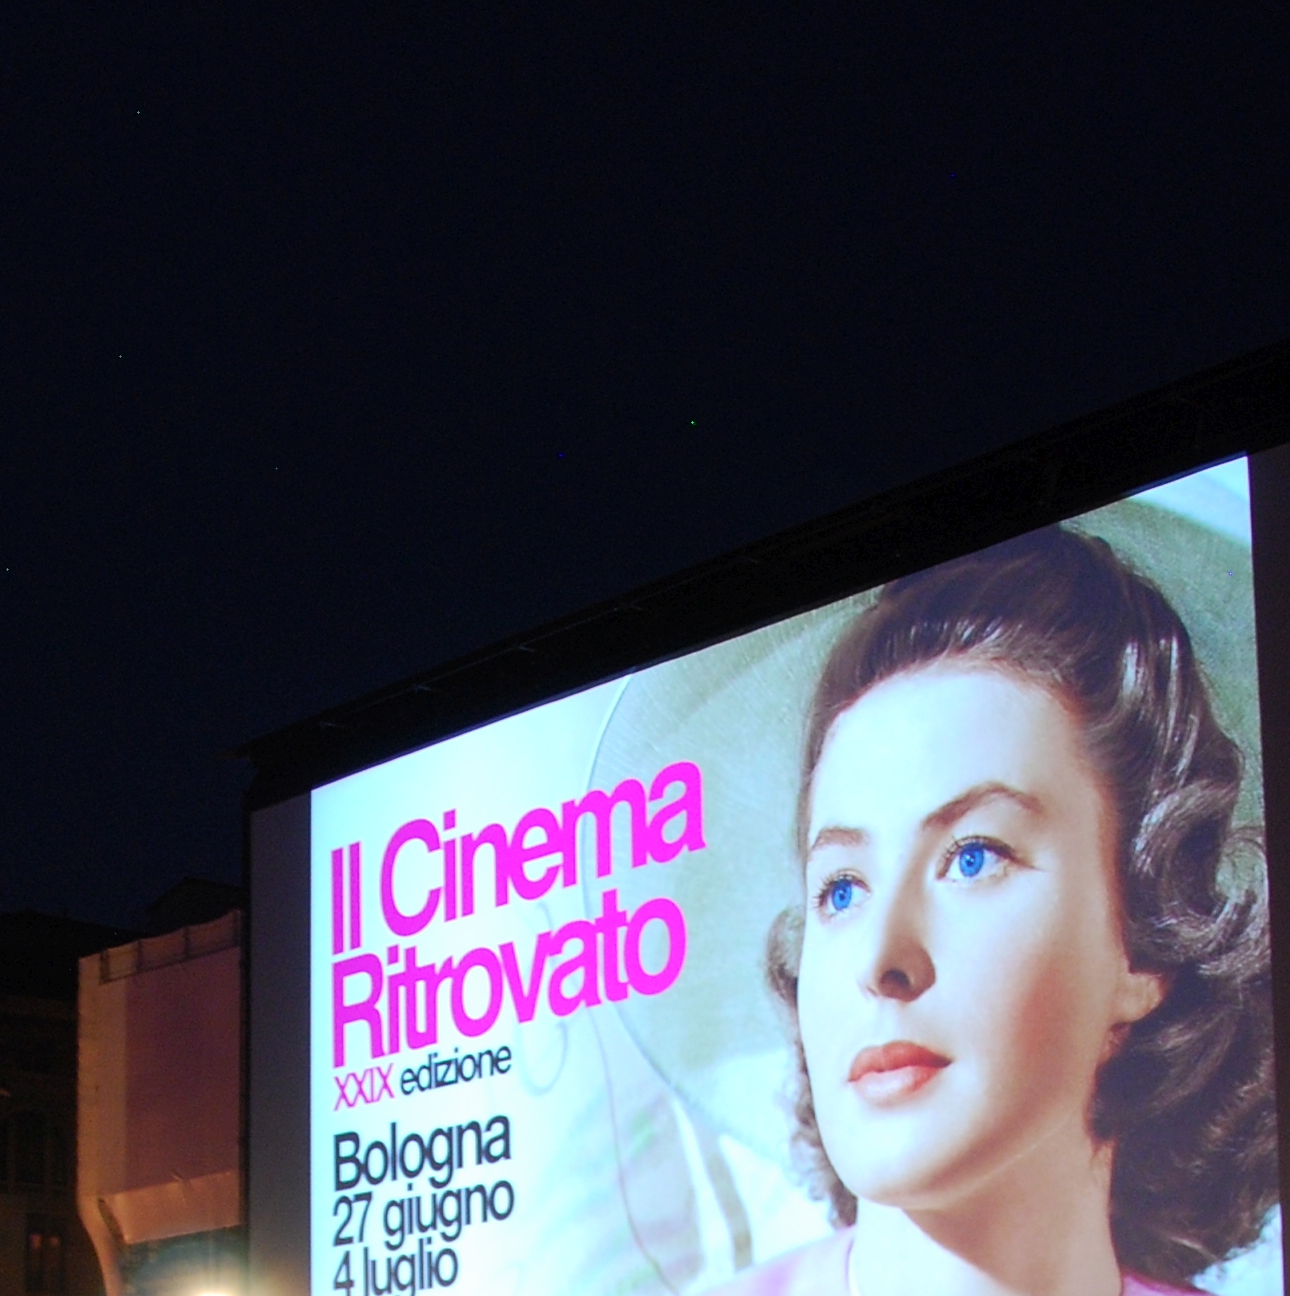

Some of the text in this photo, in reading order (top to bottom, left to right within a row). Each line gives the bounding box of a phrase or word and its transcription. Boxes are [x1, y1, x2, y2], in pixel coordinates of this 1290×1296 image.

[331, 760, 706, 955] Il Cinema
[331, 888, 688, 1069] Ritrovato
[333, 1046, 513, 1112] XXIX edizione
[333, 1114, 512, 1191] Bologna
[332, 1180, 516, 1251] 27 giugno
